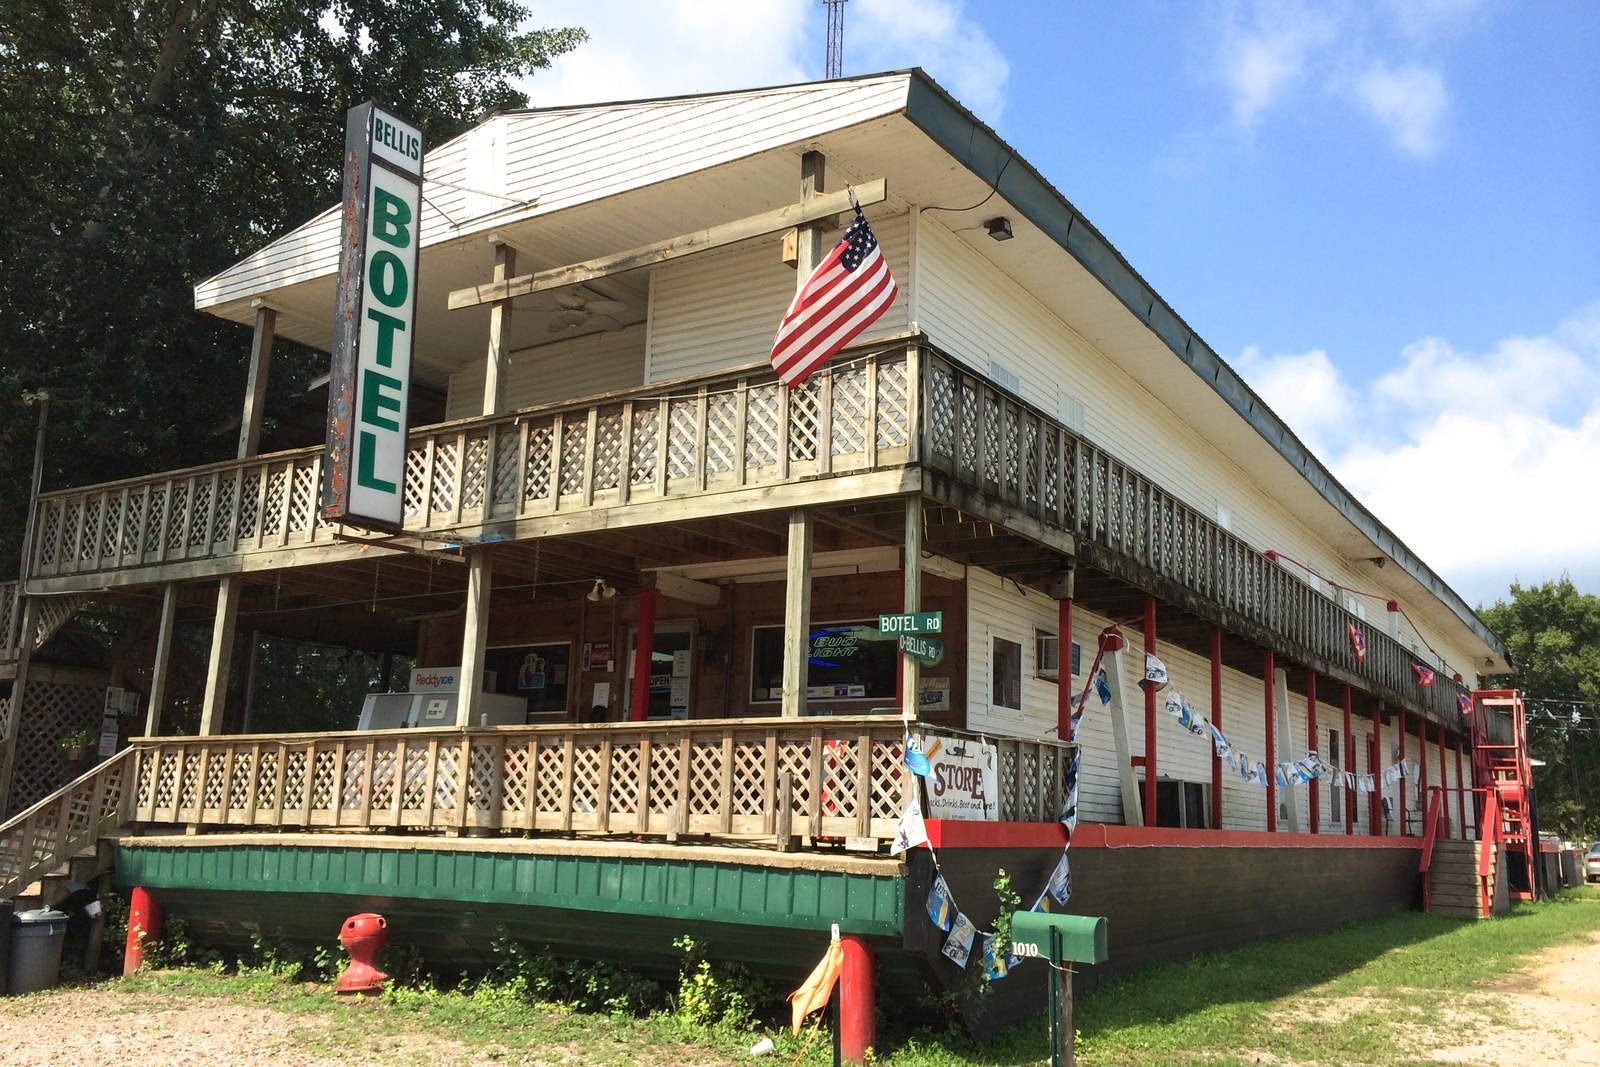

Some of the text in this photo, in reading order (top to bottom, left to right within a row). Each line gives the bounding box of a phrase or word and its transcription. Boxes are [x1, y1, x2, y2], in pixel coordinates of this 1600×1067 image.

[375, 117, 419, 161] BELLIS
[357, 185, 411, 495] BOTEL
[881, 616, 940, 632] BOTEL RD
[813, 636, 858, 648] BUD
[928, 646, 936, 659] RD
[650, 675, 671, 686] OPEN
[934, 762, 984, 799] STORE
[970, 800, 982, 810] and
[1012, 941, 1038, 957] 1010
